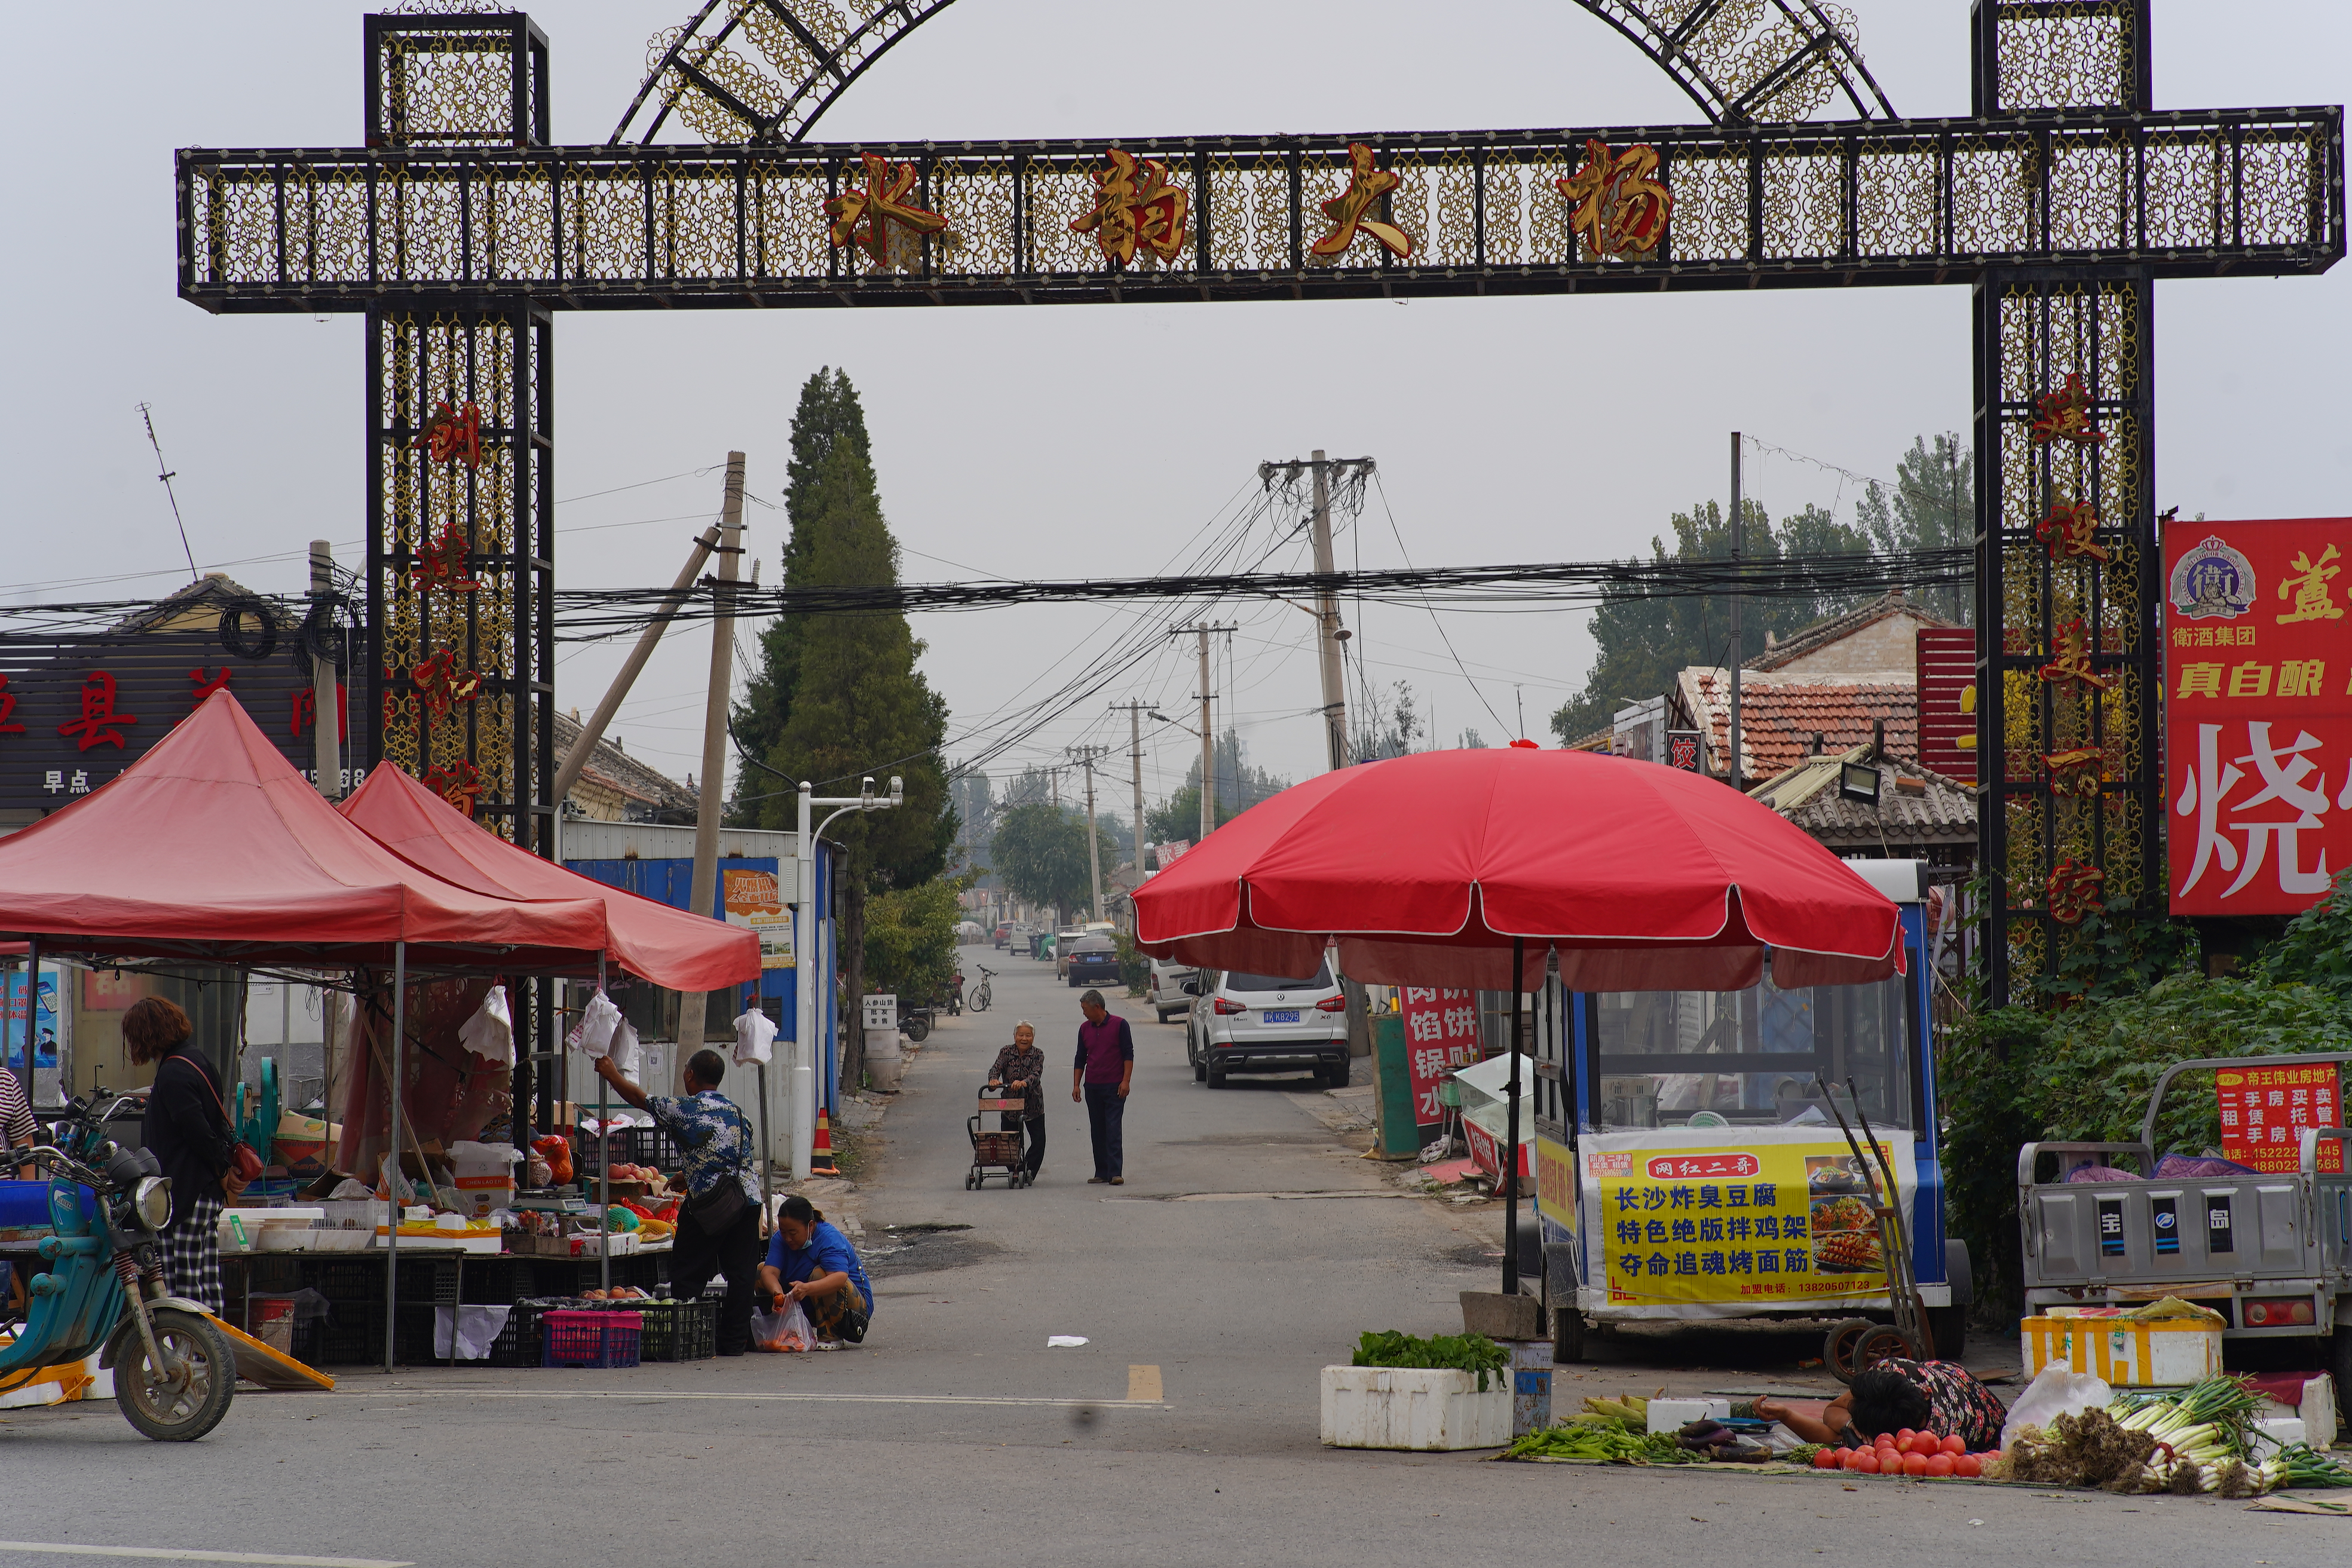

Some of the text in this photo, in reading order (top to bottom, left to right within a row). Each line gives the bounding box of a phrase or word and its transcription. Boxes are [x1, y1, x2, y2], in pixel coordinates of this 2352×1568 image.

[2276, 543, 2352, 624] 蘆
[2173, 626, 2255, 647] 衛酒集团
[2034, 372, 2109, 1010] 建设美丽家
[2177, 659, 2325, 698] 真自酿
[1671, 738, 1696, 769] 饺
[44, 769, 90, 794] 早点
[2177, 721, 2352, 900] 烧
[1410, 1006, 1476, 1042] 馅饼
[2247, 1068, 2336, 1086] 帝王伟业房地产
[2222, 1088, 2332, 1107] 二手房买卖
[2222, 1106, 2332, 1126] 租赁 托管
[2223, 1145, 2339, 1160] 电话：152222445
[2253, 1159, 2339, 1171] 188022568
[1655, 1156, 1753, 1177] 网红二哥
[1615, 1183, 1777, 1211] 长沙炸臭豆腐
[1616, 1215, 1808, 1244] 特色绝版拌鸡架
[2102, 1209, 2229, 1233] 宝 岛
[1619, 1248, 1808, 1278] 夺命追魂烤面筋
